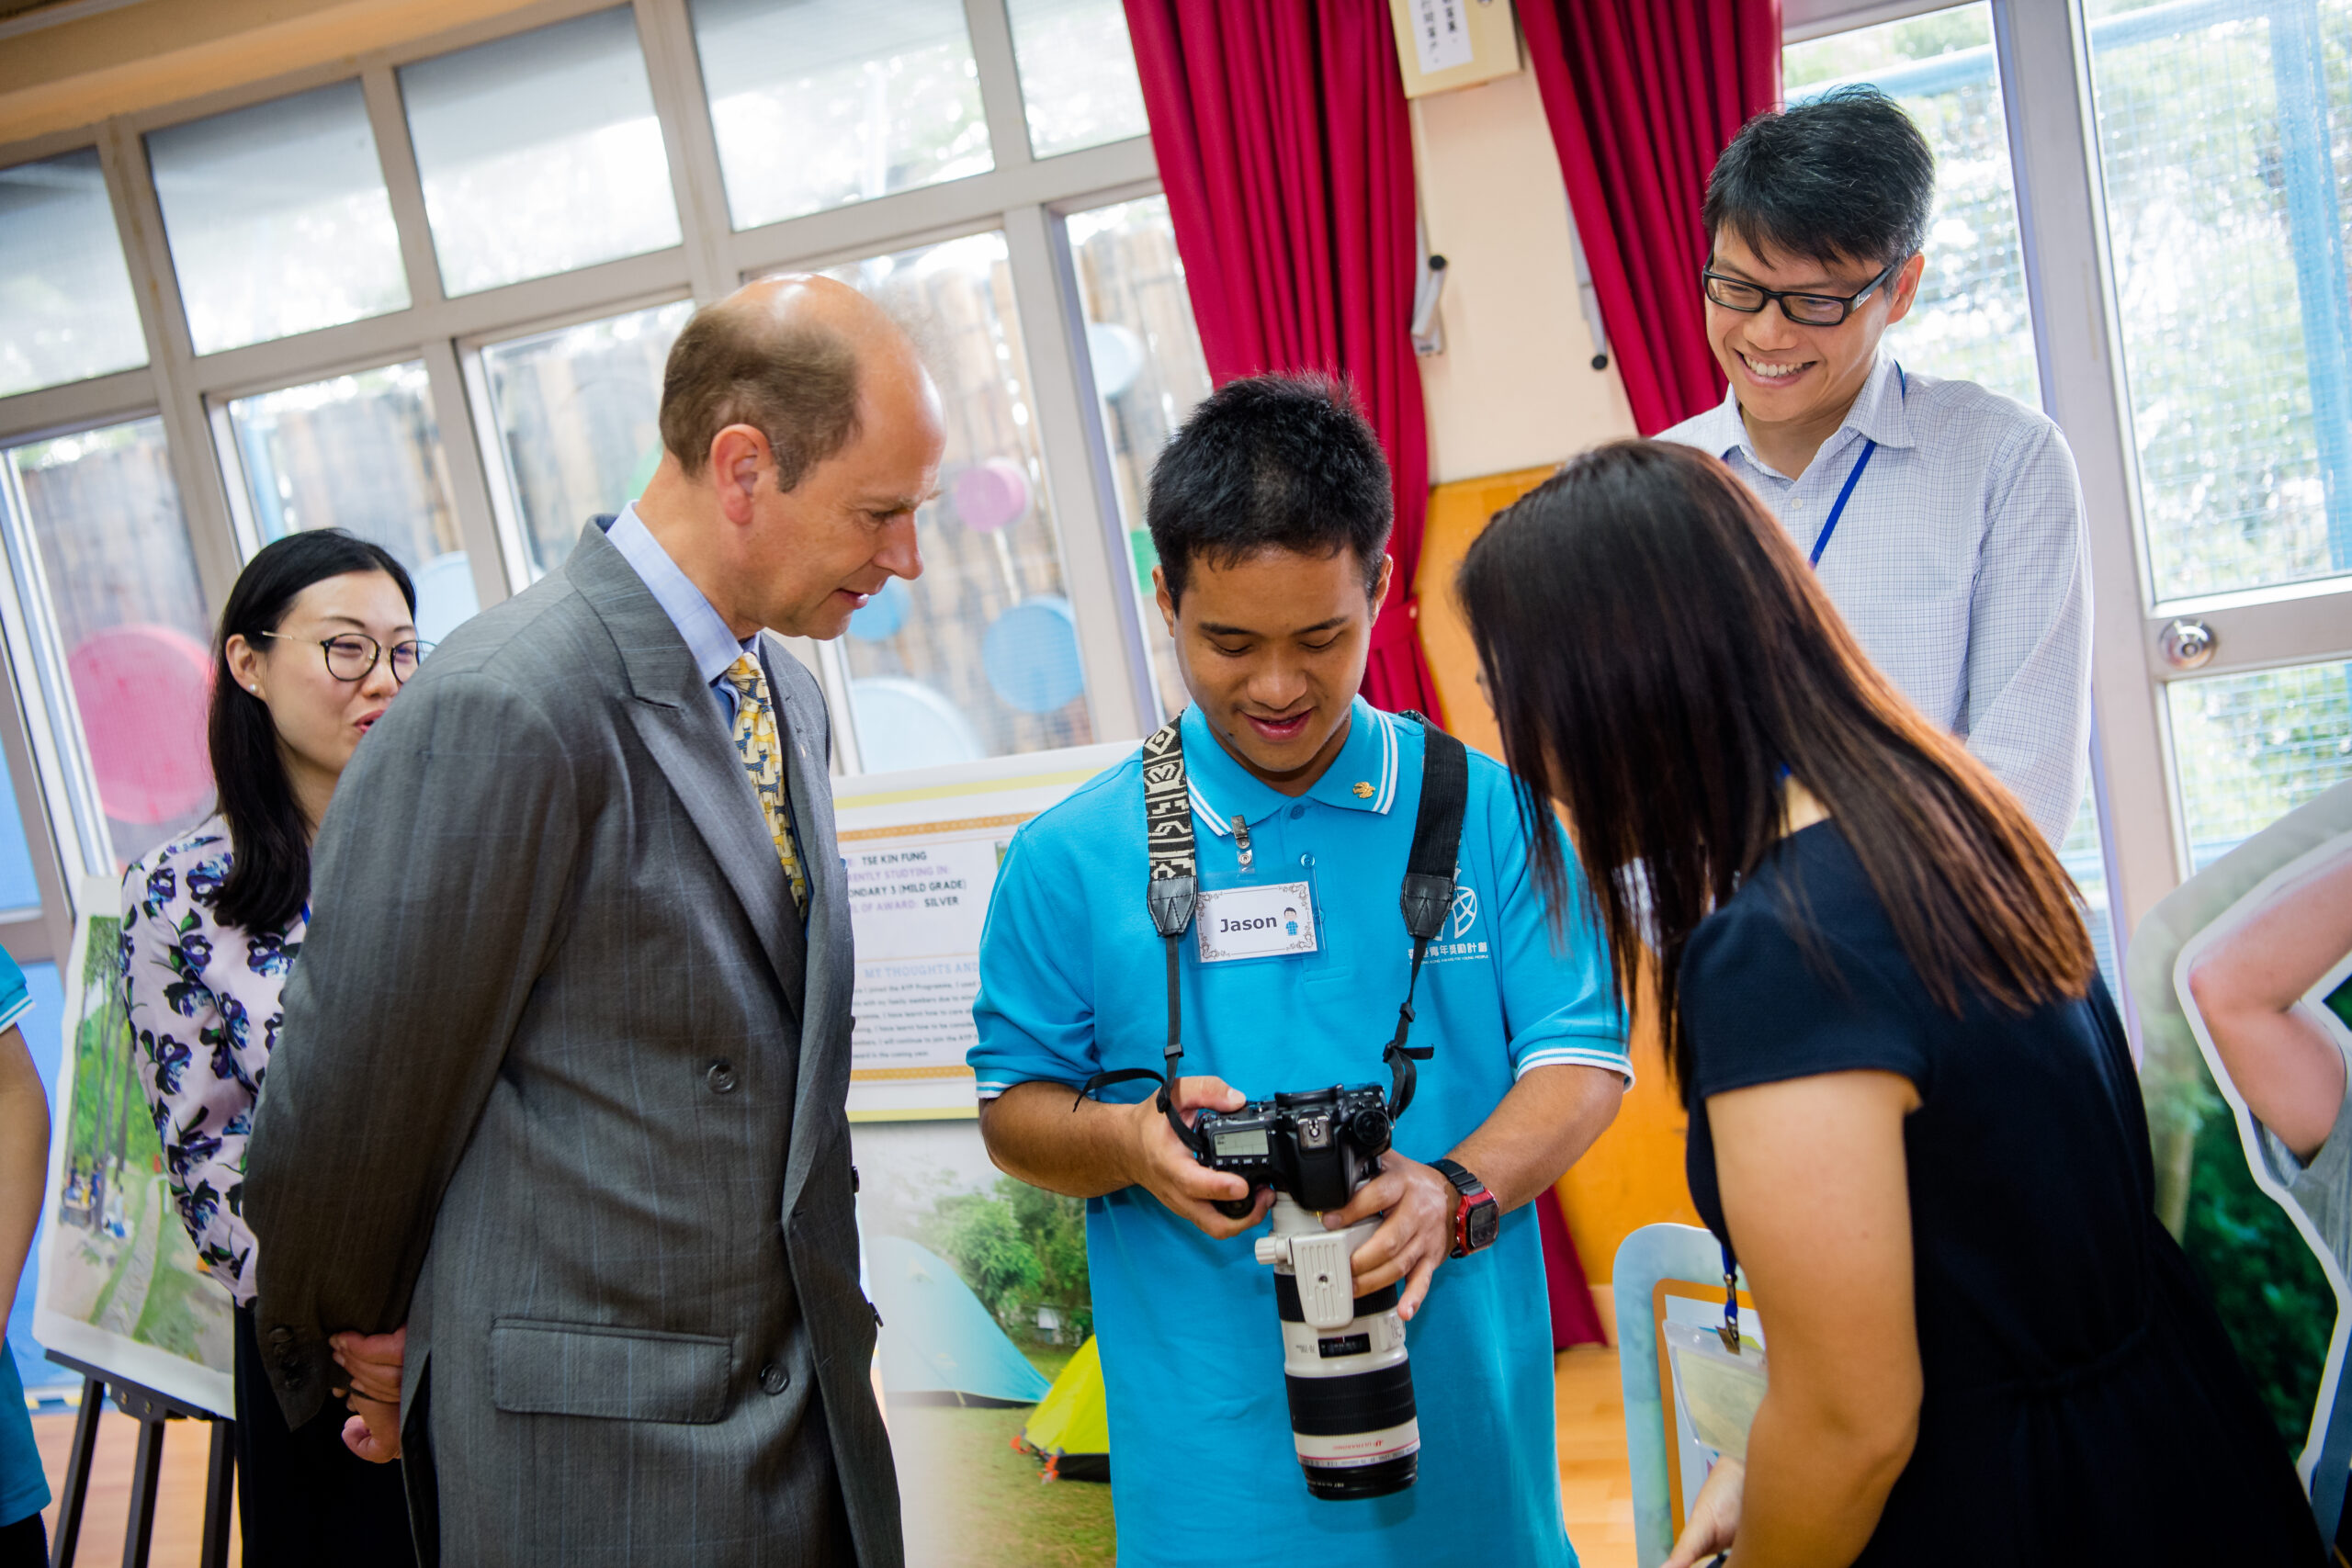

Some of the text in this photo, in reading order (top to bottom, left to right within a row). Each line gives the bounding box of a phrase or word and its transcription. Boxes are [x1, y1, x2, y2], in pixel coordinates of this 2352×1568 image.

[862, 856, 877, 865] TSE
[881, 853, 898, 864] KIN
[901, 851, 926, 862] FUNG
[886, 866, 933, 878] STUDYING
[899, 883, 926, 894] (MILD
[929, 879, 967, 891] GRADE)
[924, 897, 959, 908] SILVER
[1220, 916, 1277, 933] Jason
[865, 968, 882, 978] MY
[886, 964, 952, 977] THOUGHTS
